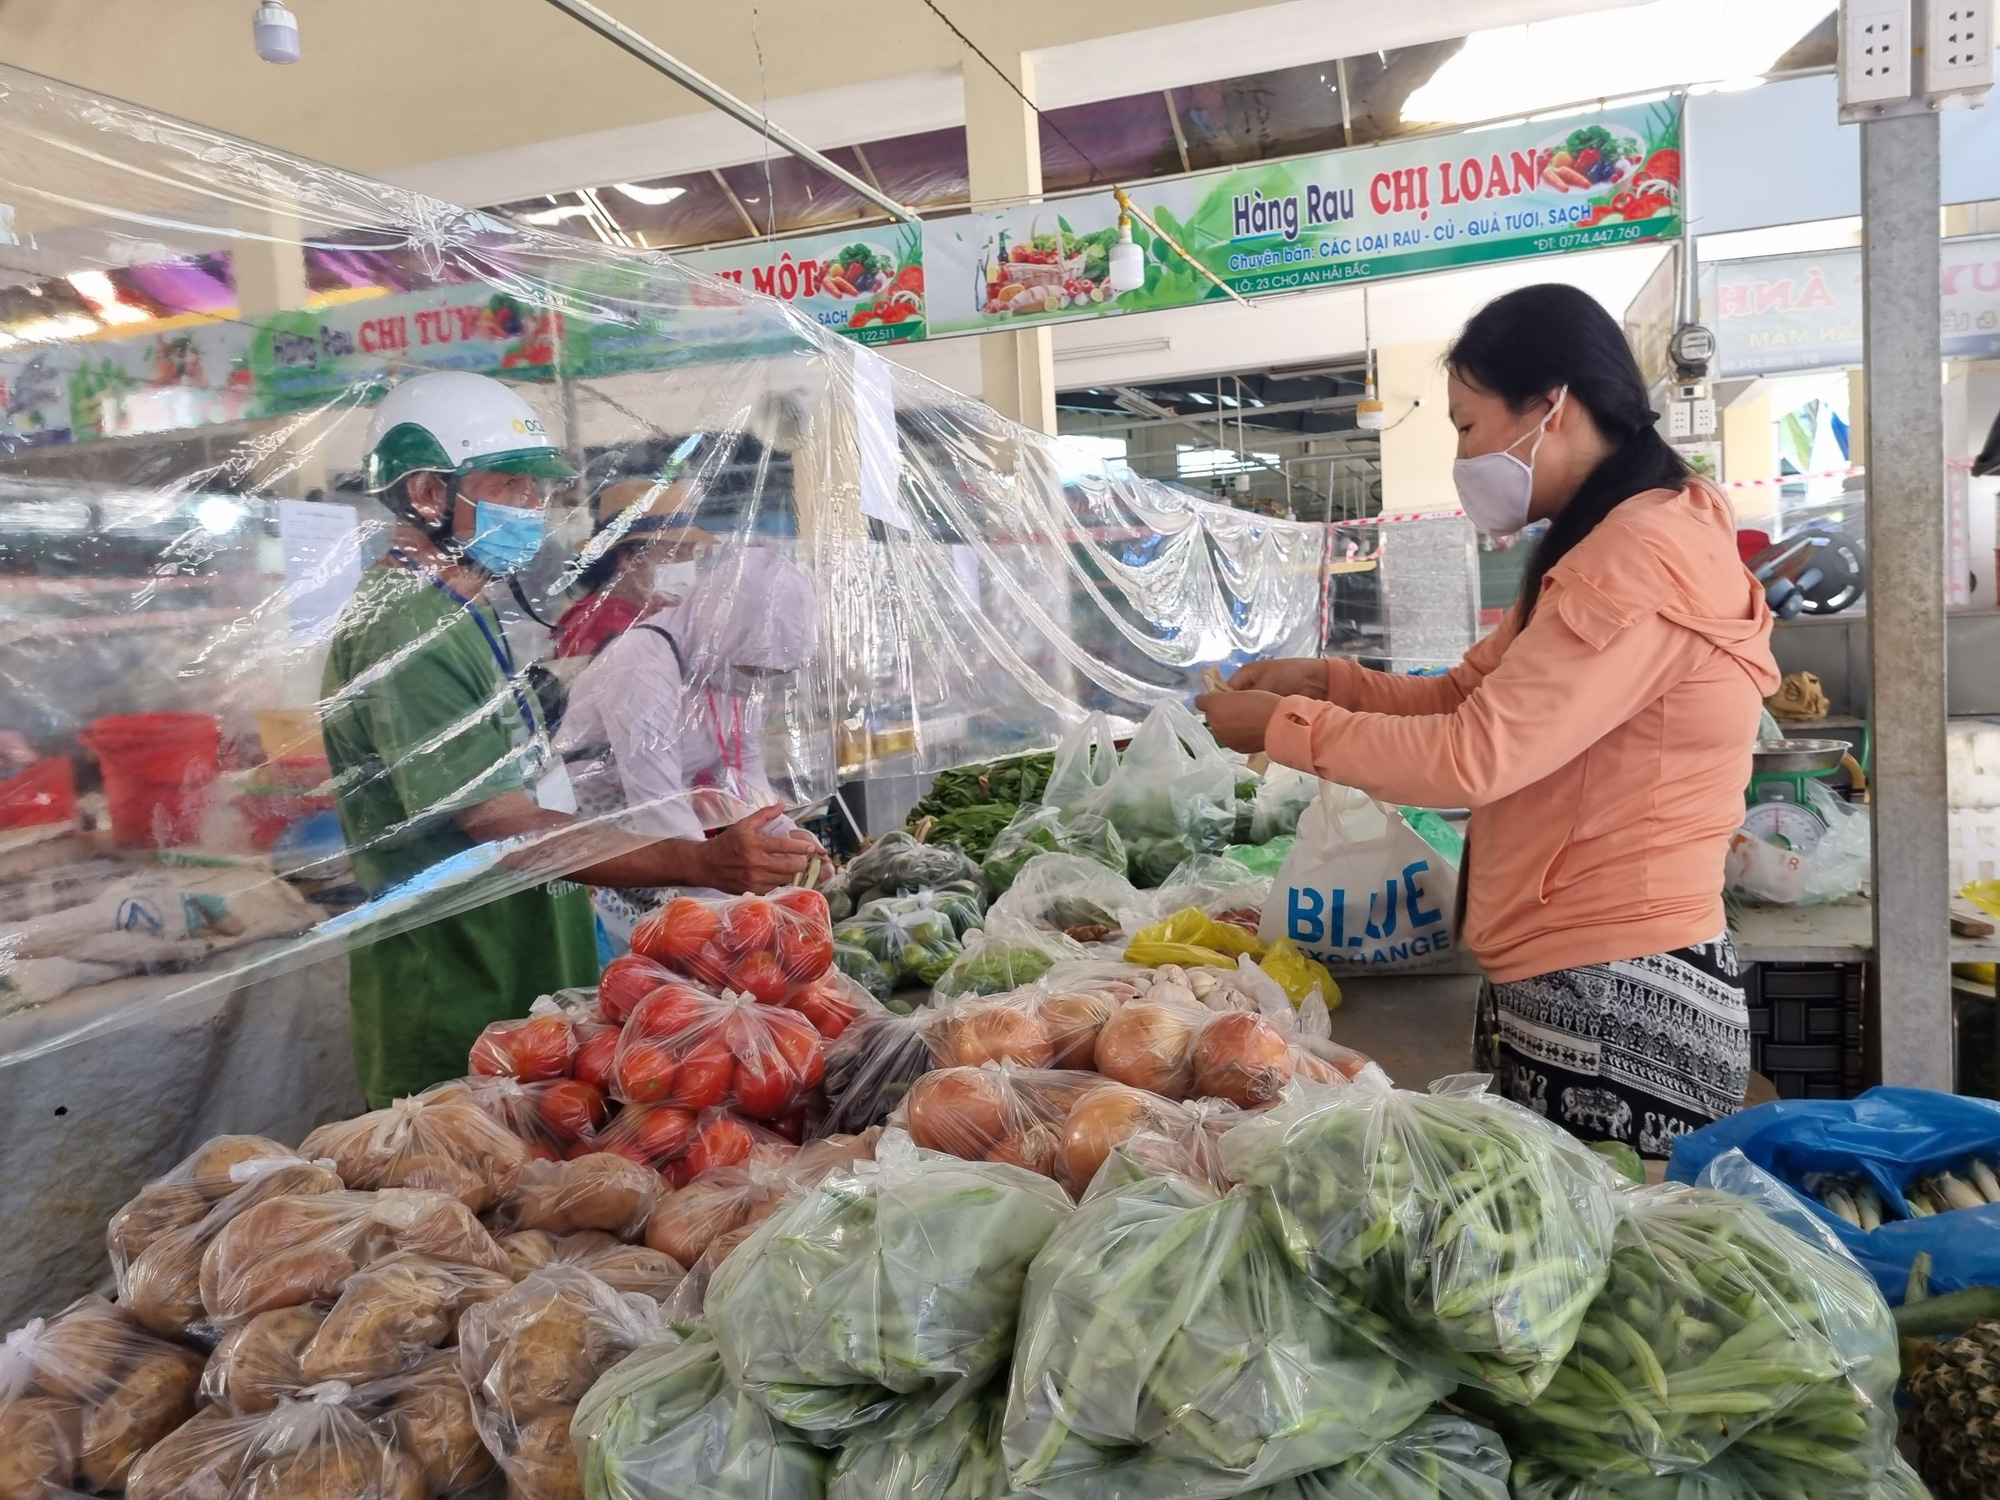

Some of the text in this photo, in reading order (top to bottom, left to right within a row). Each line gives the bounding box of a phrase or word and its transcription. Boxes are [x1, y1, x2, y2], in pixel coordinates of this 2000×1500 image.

[1234, 149, 1537, 240] Hàng Rau CHỊ LOAN
[1229, 250, 1280, 271] Chuyên
[1284, 244, 1315, 264] bán:
[1319, 237, 1351, 258] CÁC
[1356, 233, 1388, 254] LOẠI
[1394, 229, 1421, 247] RAU
[1433, 219, 1455, 241] CỦ
[1468, 212, 1501, 236] QUẢ
[1505, 211, 1544, 231] TƯƠI,
[1549, 204, 1592, 229] SẠCH
[1559, 225, 1641, 248] 0774.447.760
[1256, 278, 1270, 290] 23
[1271, 272, 1300, 287] CHỢ
[1302, 271, 1320, 283] AN
[1322, 264, 1342, 281] HẢI
[844, 328, 895, 342] 8.122.511
[1297, 930, 1449, 965] XCHANGE
